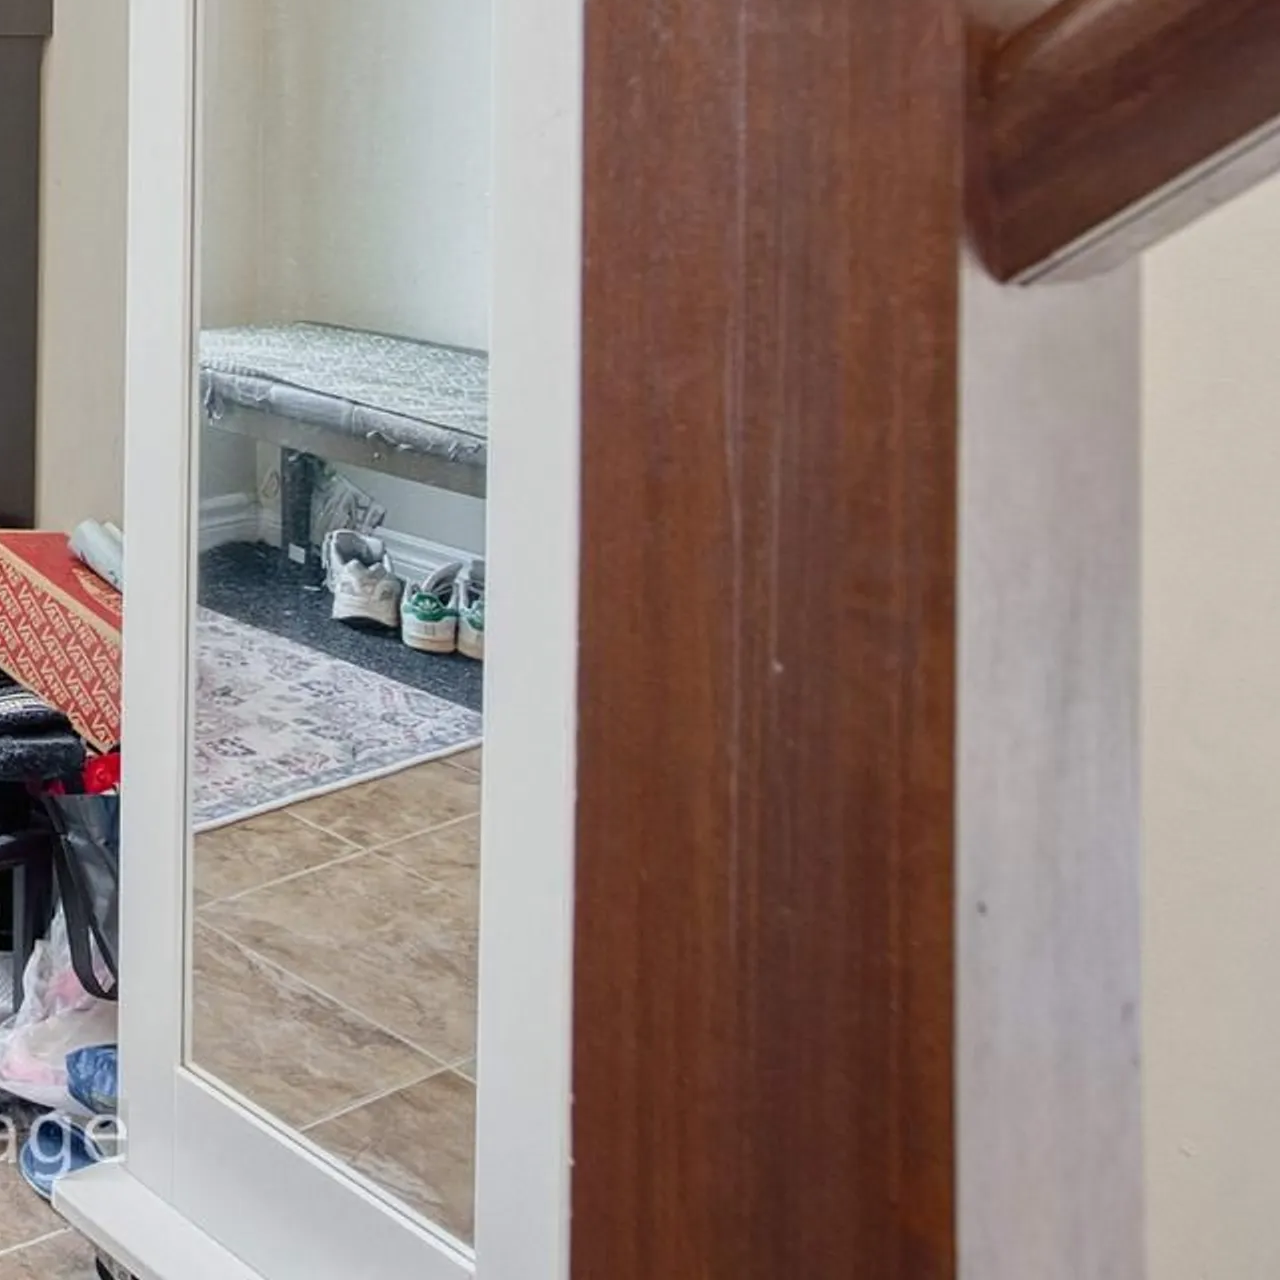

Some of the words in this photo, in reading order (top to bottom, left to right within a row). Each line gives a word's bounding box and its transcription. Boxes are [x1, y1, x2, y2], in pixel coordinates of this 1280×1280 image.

[18, 583, 48, 630] VANS
[42, 594, 73, 639] VANS
[17, 615, 46, 661] VANS
[41, 625, 71, 671] VANS
[66, 635, 97, 682] VANS
[40, 656, 72, 705] VANS
[65, 668, 98, 716] VANS
